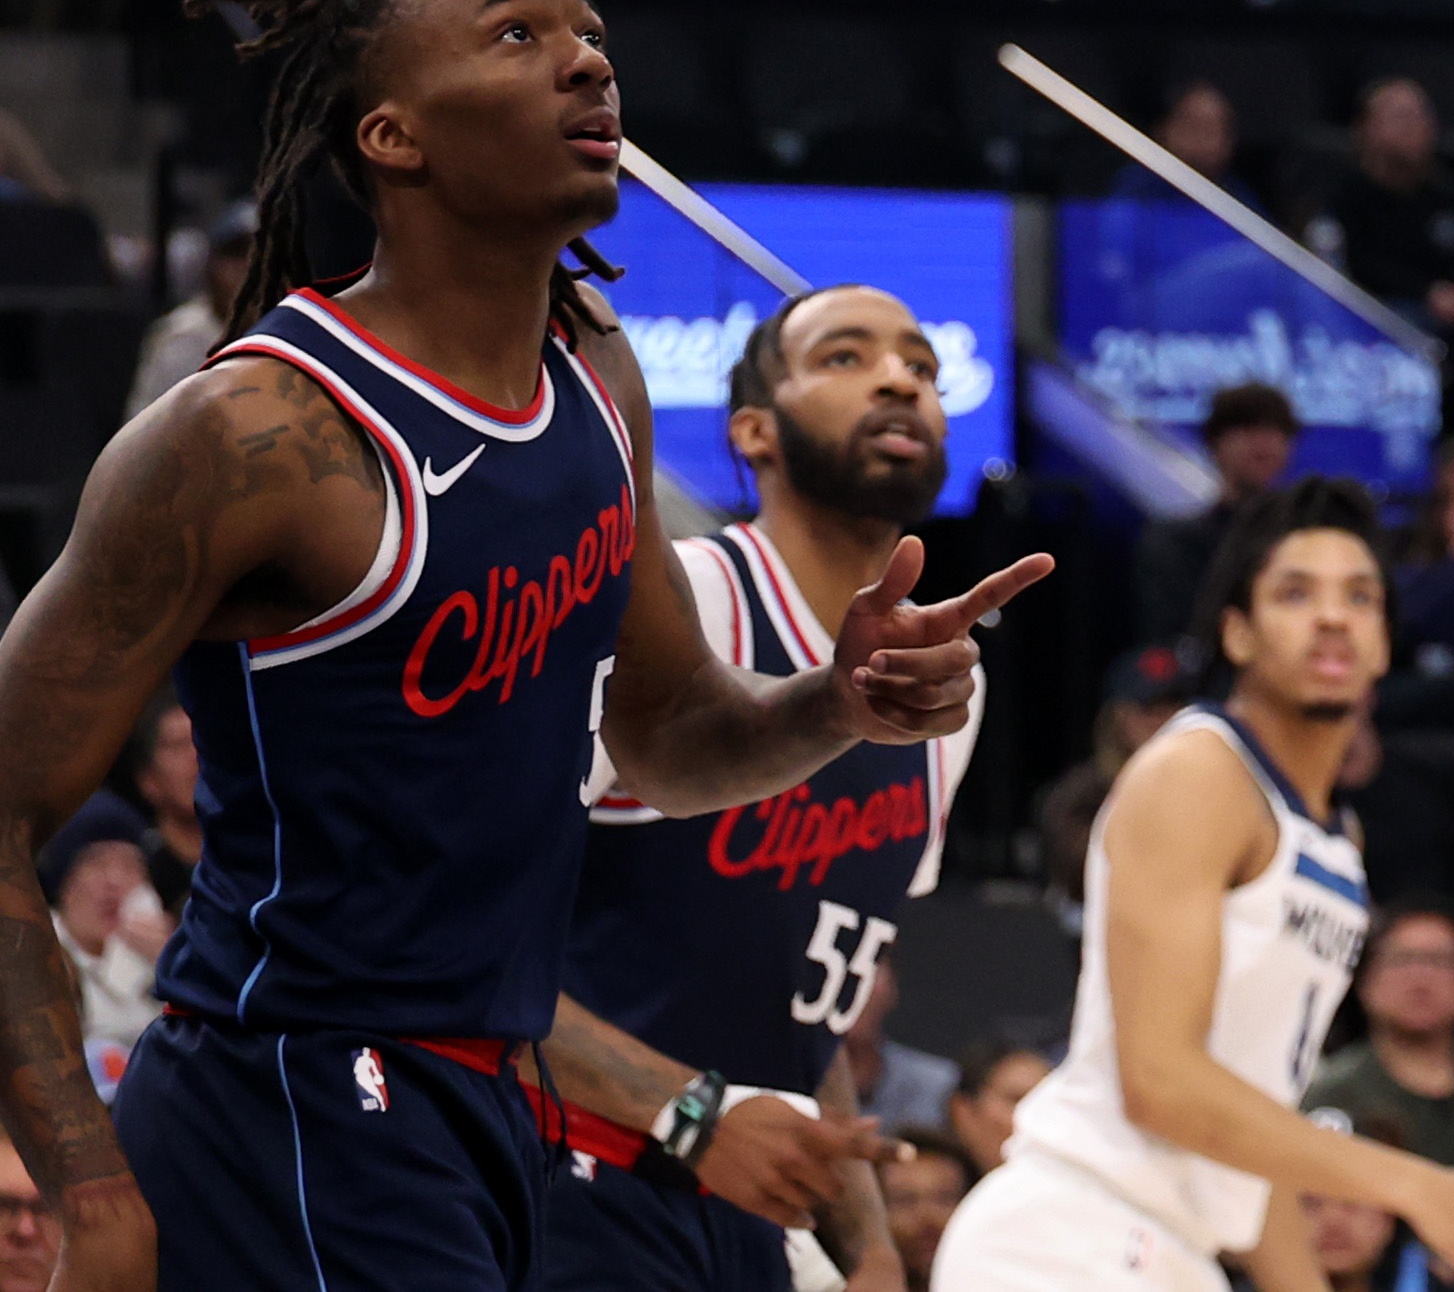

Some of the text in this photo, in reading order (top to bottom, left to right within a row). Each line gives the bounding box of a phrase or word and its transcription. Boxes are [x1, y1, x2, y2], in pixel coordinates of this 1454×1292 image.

[402, 483, 636, 718] Clippers
[707, 775, 928, 891] Clippers
[790, 899, 898, 1036] 55
